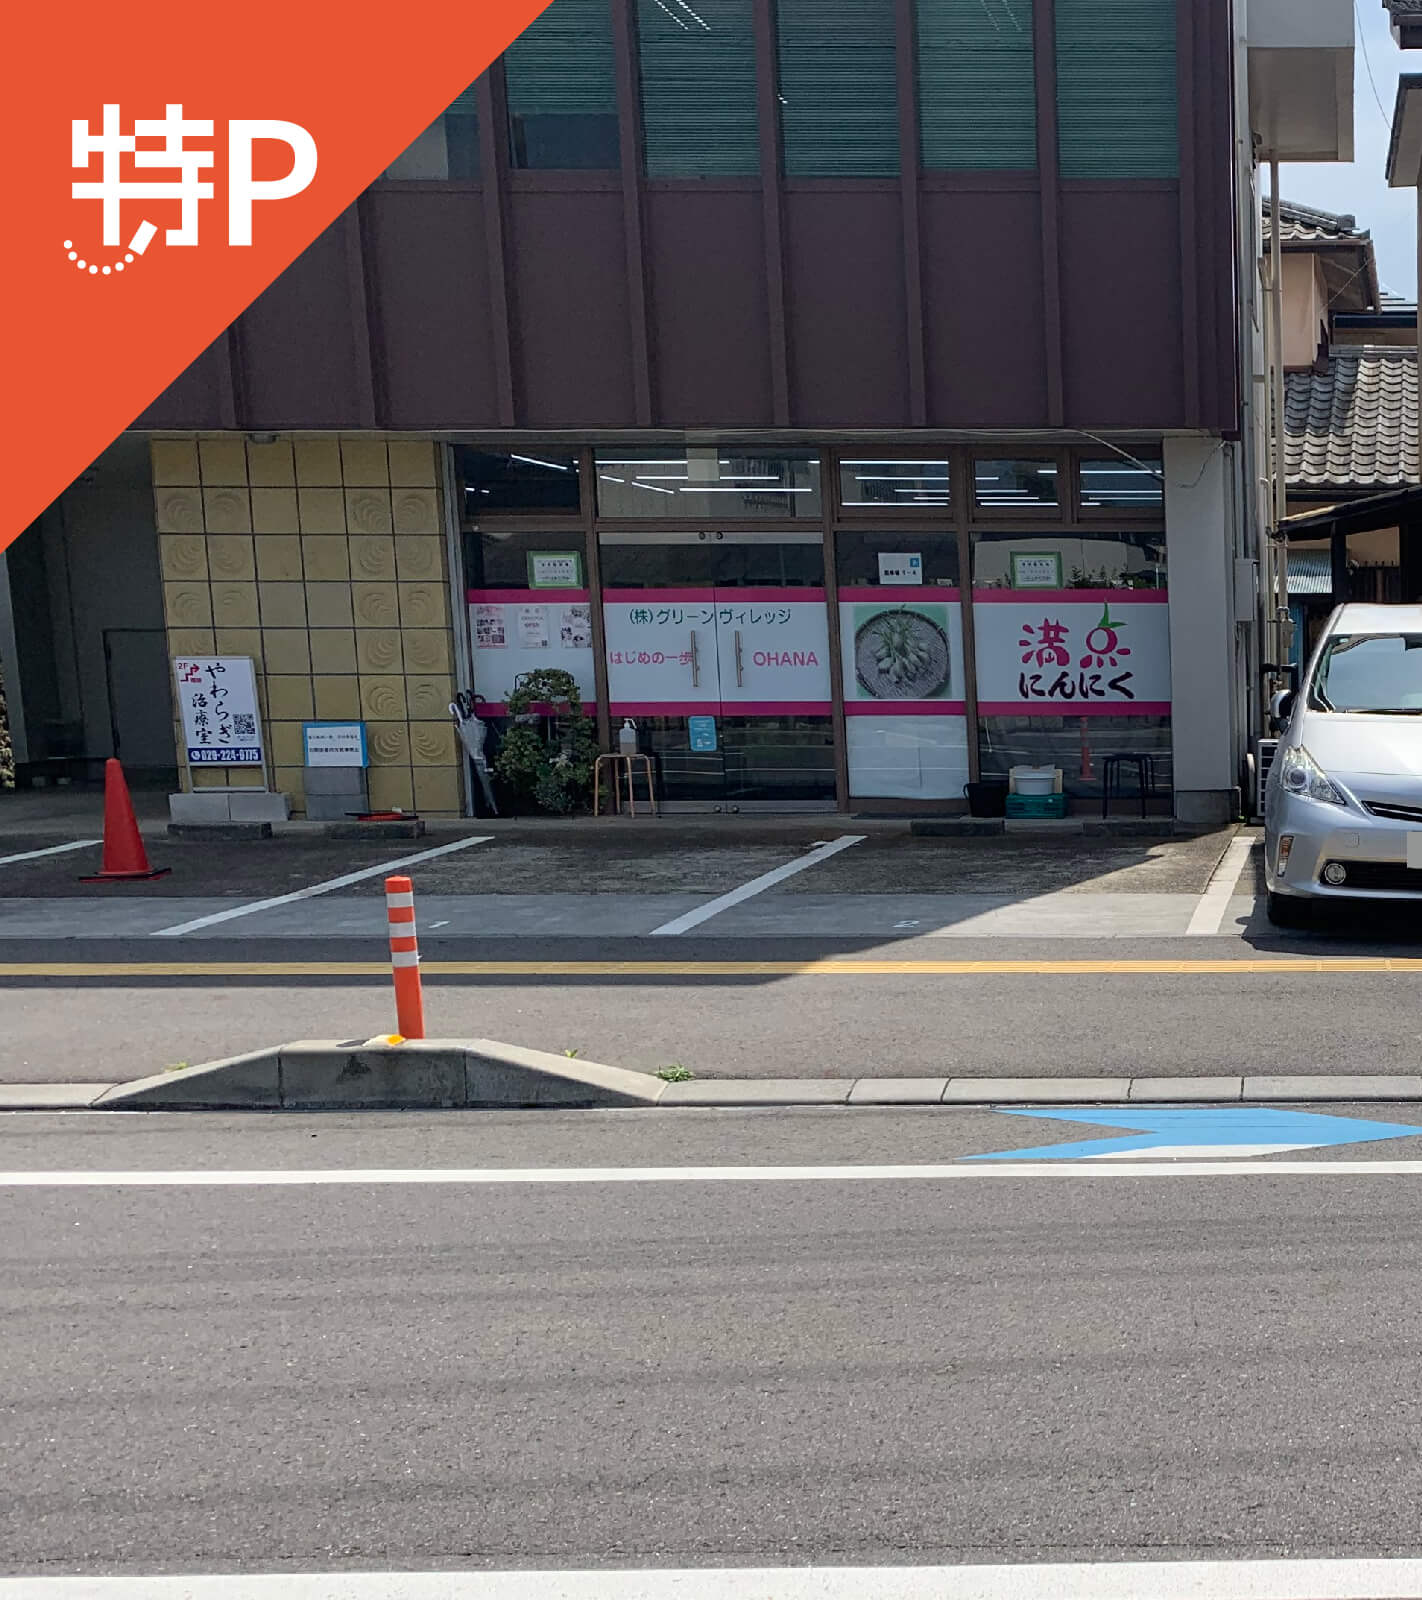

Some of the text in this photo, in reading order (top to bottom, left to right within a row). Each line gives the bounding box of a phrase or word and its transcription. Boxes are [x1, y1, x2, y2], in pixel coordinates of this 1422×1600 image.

[1018, 602, 1131, 668] 満点
[752, 651, 819, 667] OHANA
[204, 662, 233, 745] やわらぎ
[1018, 670, 1135, 699] にんにく
